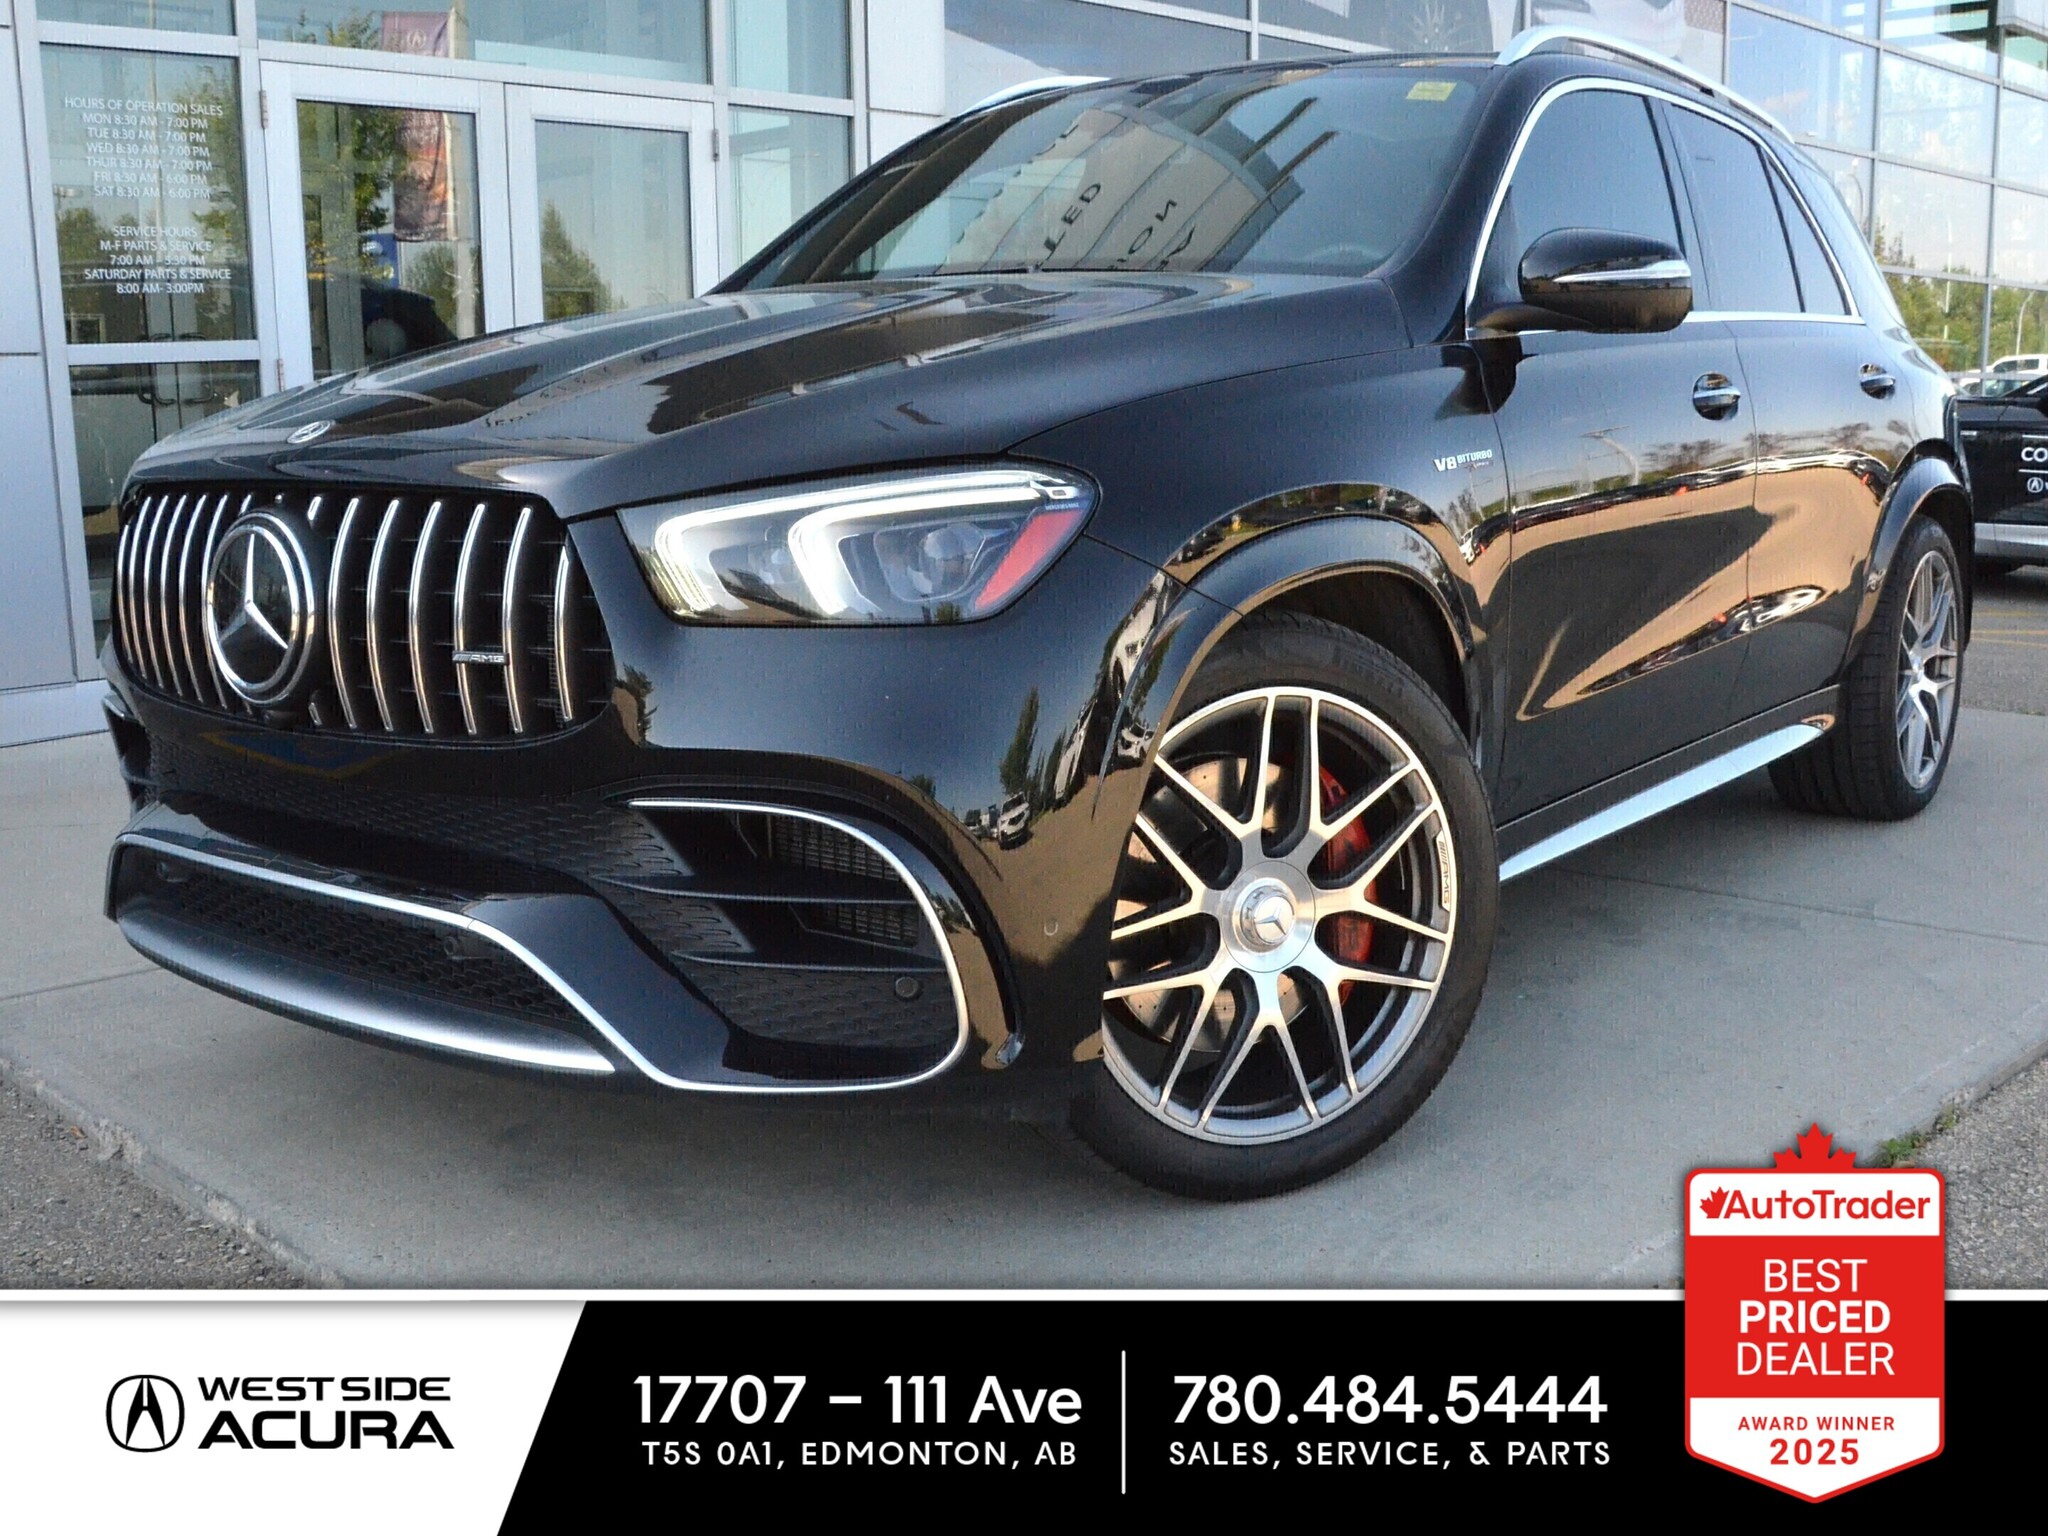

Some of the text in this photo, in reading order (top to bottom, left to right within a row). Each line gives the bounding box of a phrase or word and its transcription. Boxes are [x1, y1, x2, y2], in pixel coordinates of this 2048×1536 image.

[65, 97, 223, 116] HOURS OF OPERATION SALES
[82, 112, 112, 124] MON
[114, 114, 137, 126] 8:30
[140, 116, 157, 126] AM
[167, 117, 189, 128] 7:00
[191, 118, 208, 129] PM
[87, 127, 109, 139] TUE
[112, 128, 135, 140] 8:30
[138, 130, 155, 140] AM
[165, 131, 187, 142] 7:00
[189, 132, 206, 143] PM
[86, 142, 114, 153] WED
[116, 143, 139, 154] 8:30
[141, 145, 159, 155] AM
[168, 146, 191, 157] 7:00
[192, 147, 210, 157] PM
[86, 156, 117, 167] THUR
[120, 158, 142, 169] 8:30
[145, 160, 162, 169] AM
[172, 160, 194, 171] 7:00
[196, 161, 213, 171] PM
[94, 171, 111, 182] FRI
[114, 172, 137, 183] 8:30
[139, 173, 157, 183] AM
[166, 174, 188, 185] 6:00
[190, 175, 208, 185] PM
[94, 186, 114, 197] SAT
[117, 186, 140, 198] 8:30
[142, 187, 160, 198] AM
[168, 188, 191, 199] 6:00
[193, 188, 210, 199] PM
[113, 226, 198, 237] SERVICE HOURS
[100, 240, 212, 251] M-F PARTS & SERVICE
[110, 255, 133, 265] 7:00
[136, 255, 154, 265] AM
[189, 255, 206, 266] PM
[84, 268, 232, 280] SATURDAY PARTS & SERVICE
[116, 283, 140, 294] 8:00
[1434, 456, 1457, 471] V8
[1457, 449, 1492, 463] BITURBO
[470, 654, 505, 663] AMG
[1441, 860, 1450, 904] AMG
